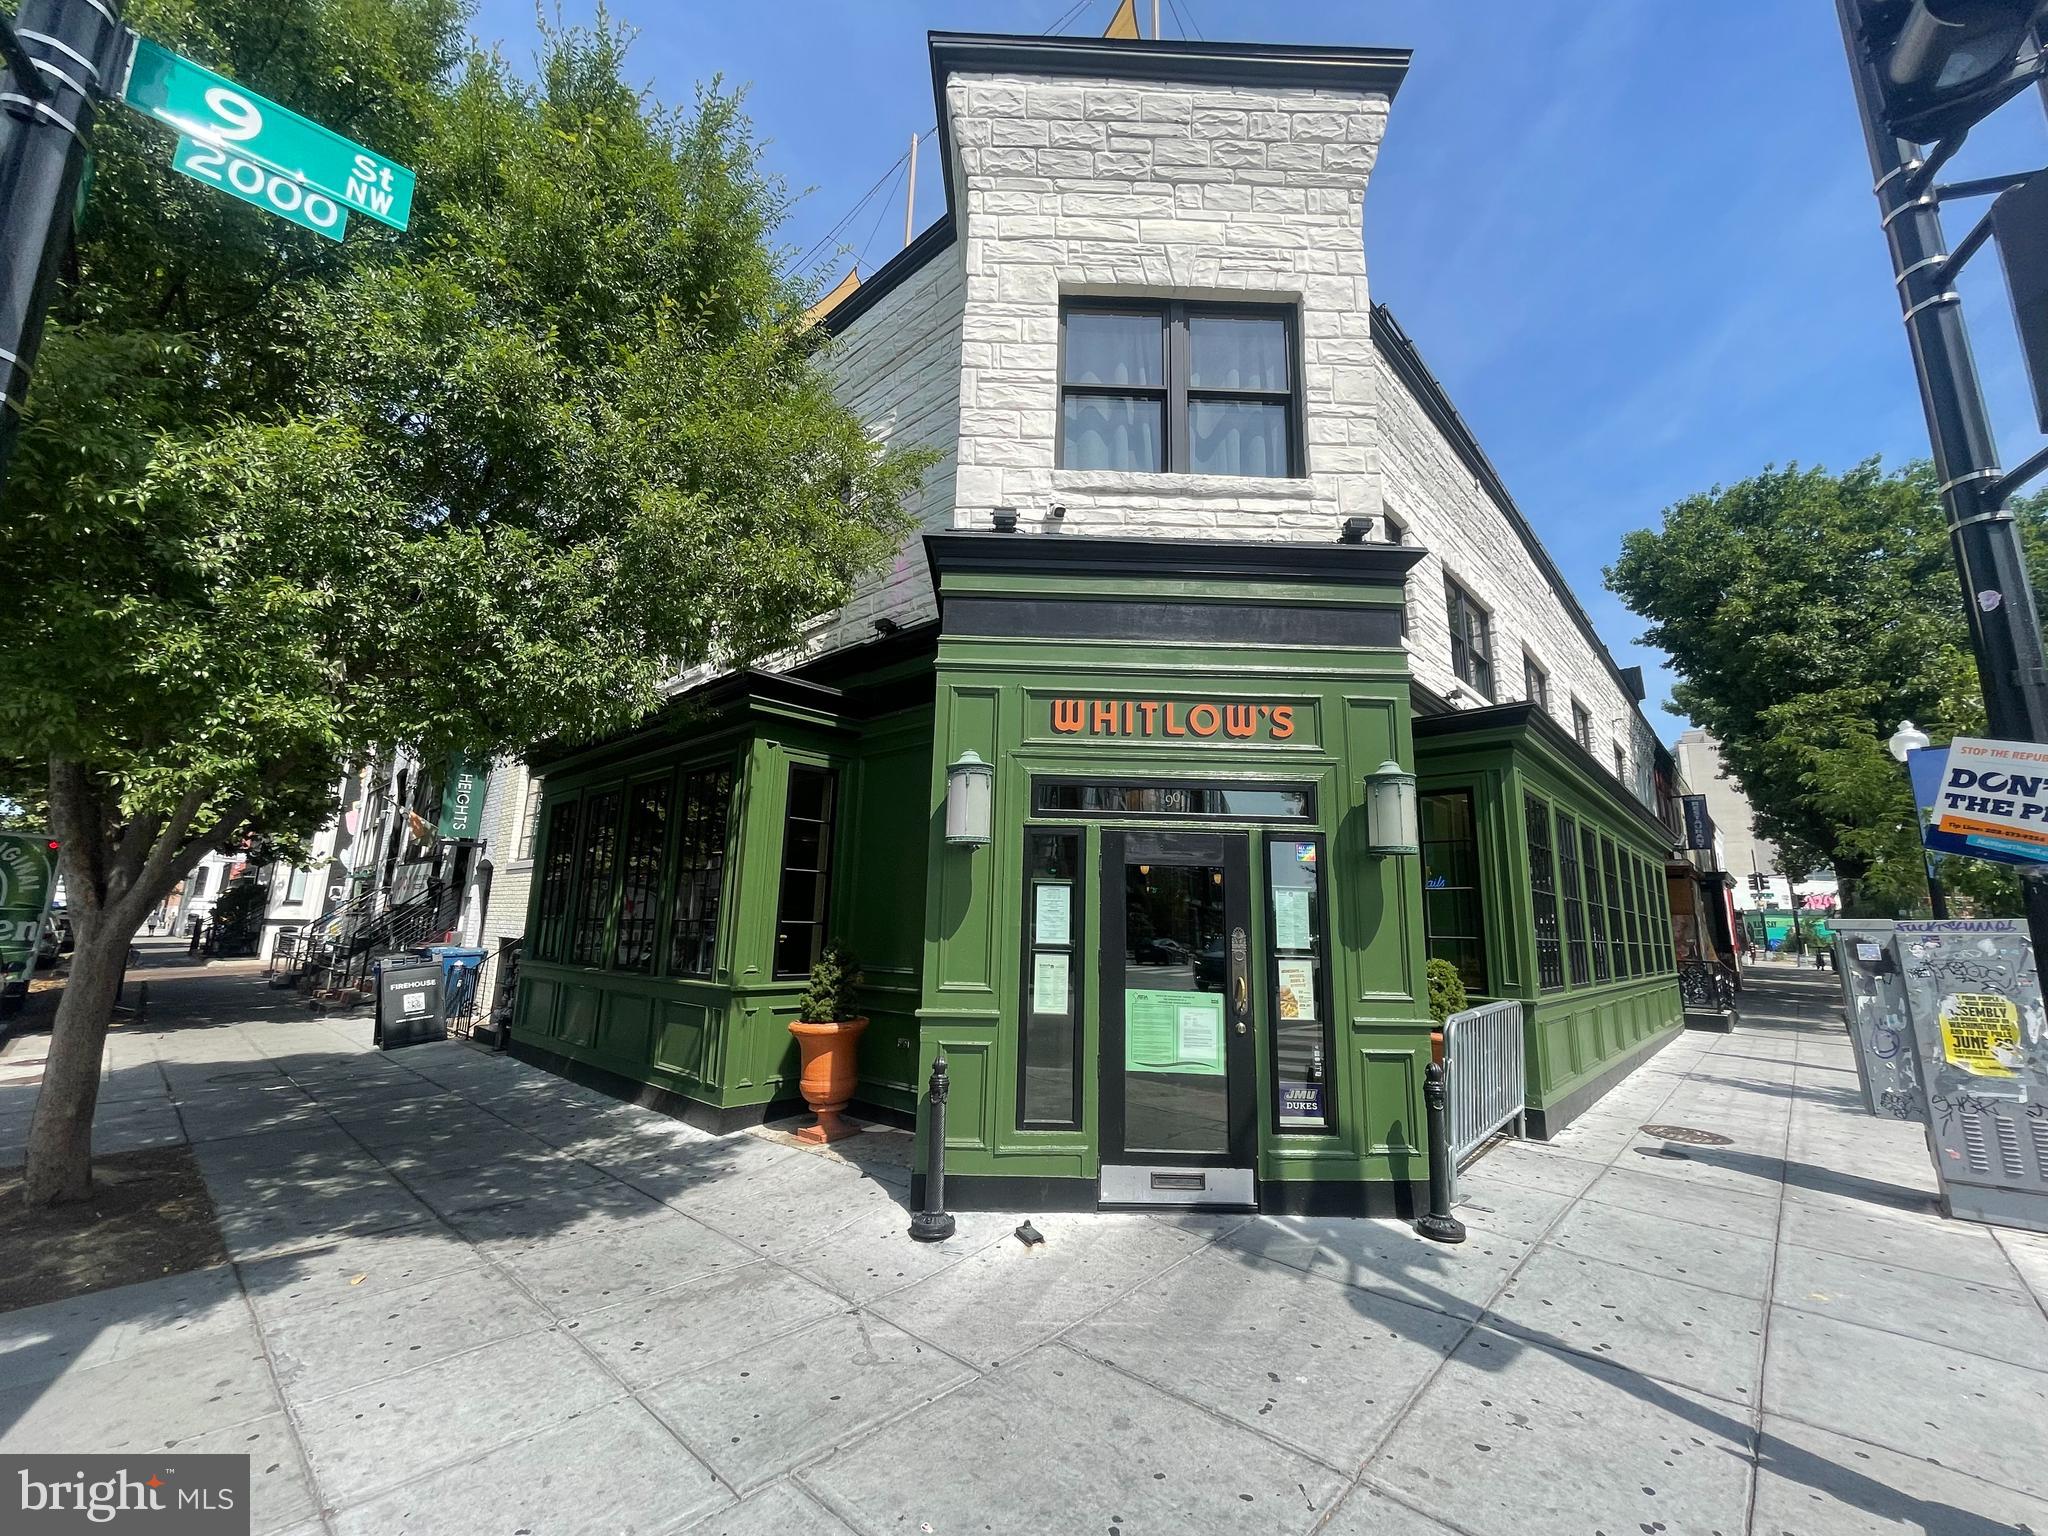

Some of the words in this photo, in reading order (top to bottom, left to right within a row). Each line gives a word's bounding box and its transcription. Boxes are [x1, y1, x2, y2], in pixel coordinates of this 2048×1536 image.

[204, 87, 263, 141] 9
[351, 153, 395, 192] St
[184, 138, 339, 228] 2000
[345, 175, 394, 217] NW
[1050, 698, 1296, 738] WHITLOW'S
[1960, 746, 1989, 756] STOP
[1990, 748, 2010, 760] THE
[453, 773, 473, 831] HEIGHTS
[1165, 792, 1185, 807] 901
[1944, 792, 2015, 818] THE
[390, 979, 437, 991] FIREHOUSE
[1953, 1035, 1990, 1050] JUNE
[1285, 1090, 1317, 1100] JMU
[1286, 1102, 1318, 1111] DUKES
